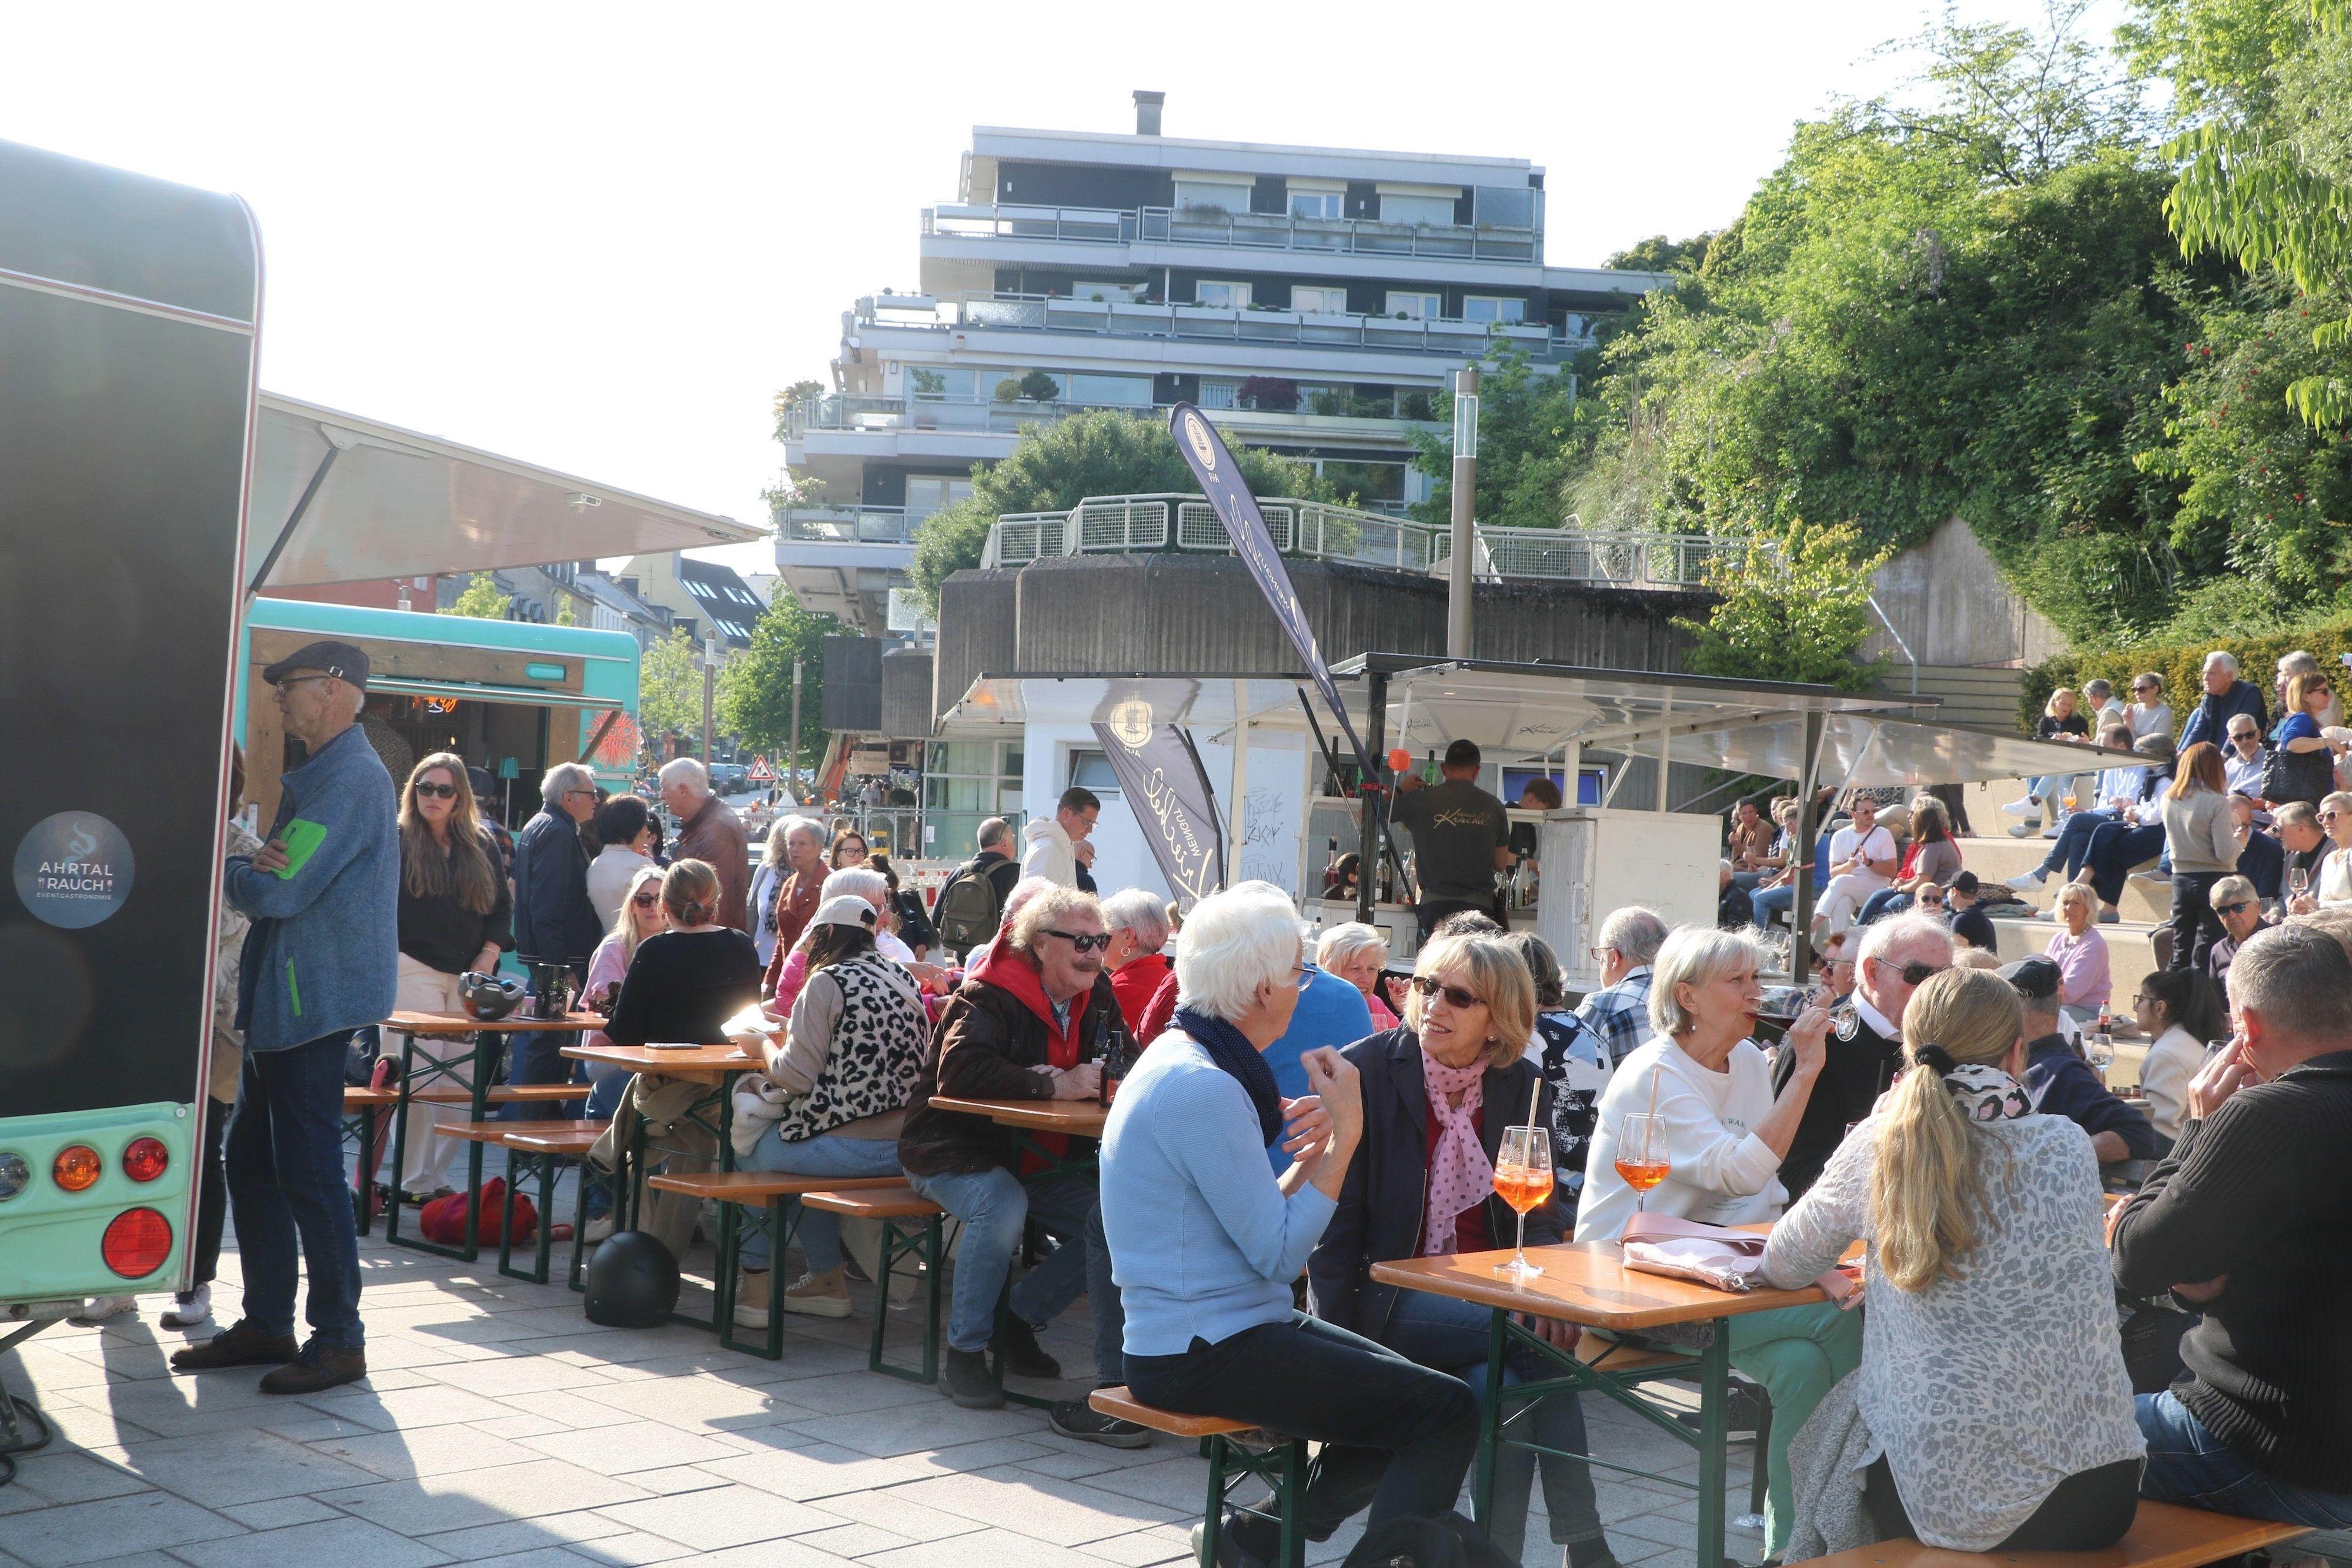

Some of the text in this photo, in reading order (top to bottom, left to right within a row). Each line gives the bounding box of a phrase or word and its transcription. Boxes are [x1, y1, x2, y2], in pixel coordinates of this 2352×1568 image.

[39, 861, 113, 876] AHRTAL
[47, 877, 103, 891] RAUCH
[36, 892, 112, 901] EVENTGASTRONOMIE
